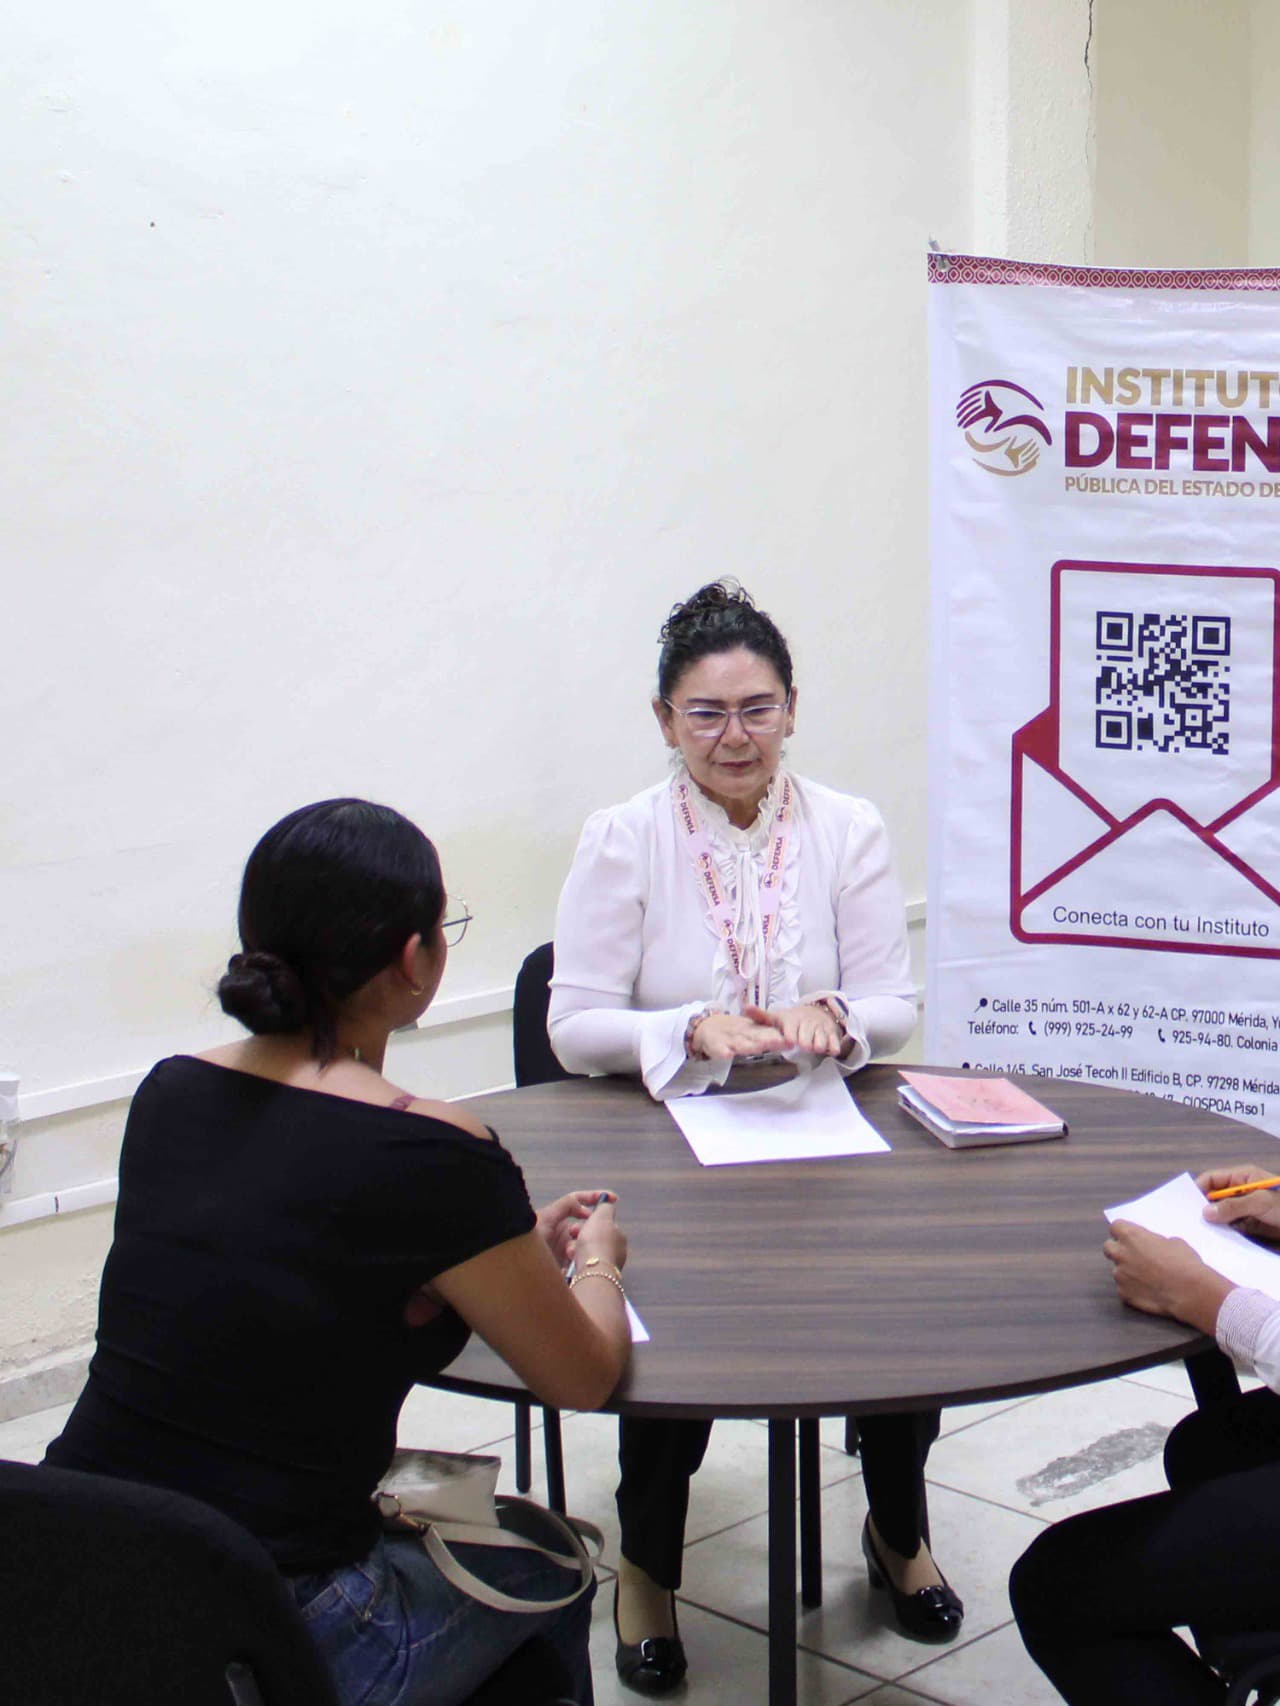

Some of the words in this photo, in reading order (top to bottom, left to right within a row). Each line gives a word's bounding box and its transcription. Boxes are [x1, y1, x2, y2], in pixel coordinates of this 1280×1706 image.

[1065, 473, 1140, 495] PÚBLICA
[1145, 479, 1178, 496] DEL
[1182, 480, 1255, 498] ESTADO
[680, 801, 696, 835] DEFENSA
[771, 836, 784, 871] DEFENSA
[704, 871, 721, 907] DEFENSA
[1053, 906, 1128, 927] Conecta
[1135, 915, 1166, 931] con
[1174, 916, 1190, 932] tu
[1197, 916, 1270, 938] Instituto
[992, 999, 1022, 1013] Calle
[1023, 999, 1038, 1013] 35
[1072, 1000, 1105, 1015] 501-A
[1107, 1005, 1114, 1014] x
[1117, 1003, 1130, 1017] 62
[1133, 1008, 1142, 1020] y
[1142, 1005, 1169, 1021] 62-A
[1170, 1008, 1189, 1022] CP.
[1191, 1008, 1226, 1026] 97000
[1228, 1010, 1269, 1031] Mérida,
[968, 1020, 1019, 1036] Teléfono:
[1044, 1021, 1072, 1037] (999)
[1075, 1022, 1134, 1039] 925-24-99
[1172, 1030, 1234, 1049] 925-94-80.
[1236, 1035, 1278, 1052] Colonia
[1031, 1063, 1054, 1078] San
[1056, 1064, 1083, 1079] José
[1085, 1064, 1119, 1081] Tecoh
[1131, 1068, 1170, 1085] Edificio
[1172, 1073, 1183, 1088] B,
[1185, 1073, 1203, 1088] CP.
[1206, 1075, 1240, 1091] 97298
[1234, 1100, 1258, 1115] Piso
